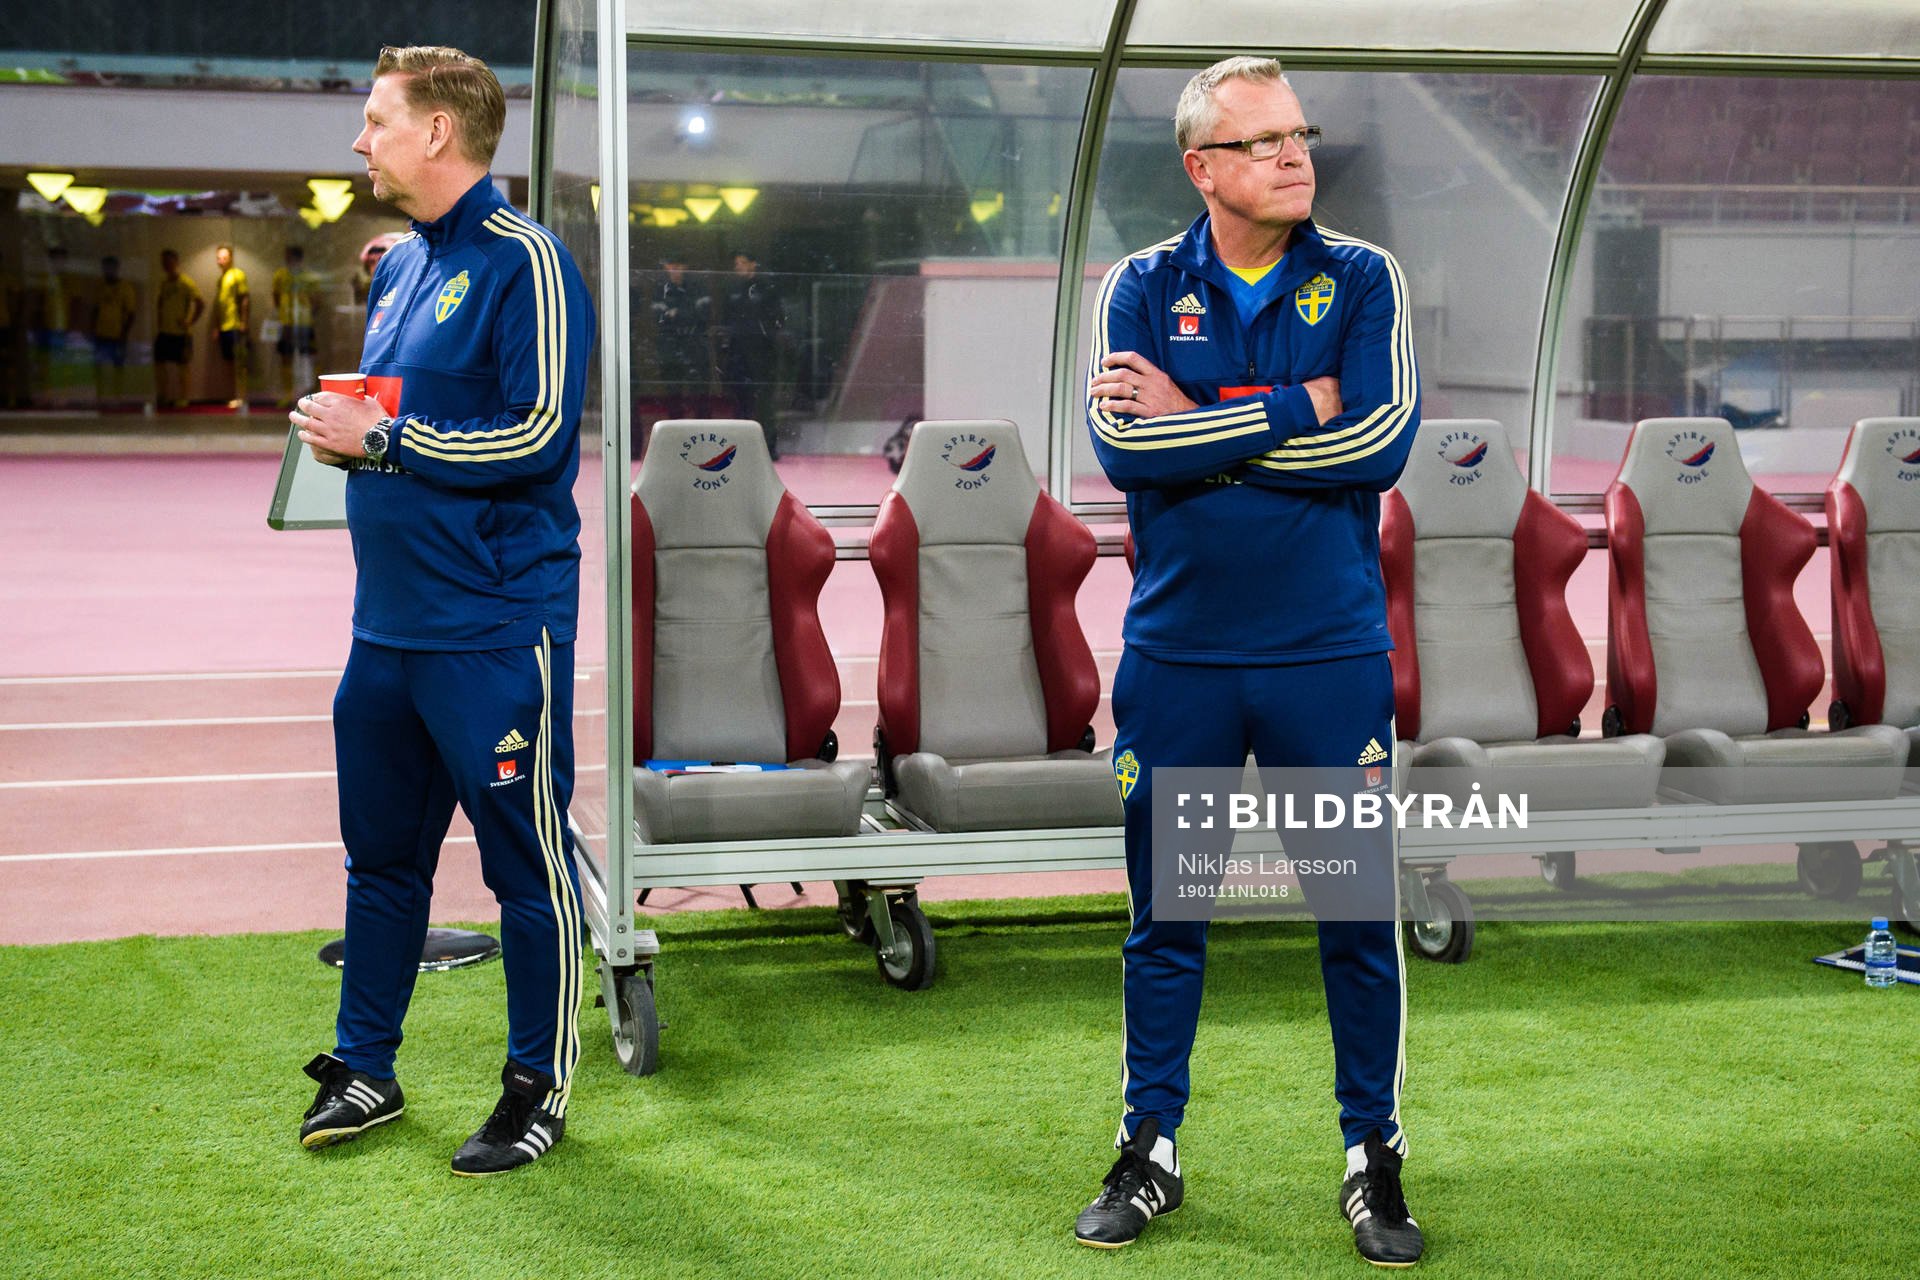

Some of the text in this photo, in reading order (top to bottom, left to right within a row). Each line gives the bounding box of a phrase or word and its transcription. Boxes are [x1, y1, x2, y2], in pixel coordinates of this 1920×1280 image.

[680, 433, 728, 461] ASPIRE
[941, 434, 987, 461] ASPIRE
[1438, 431, 1479, 458] ASPIRE
[1665, 431, 1706, 457] ASPIRE
[1886, 429, 1920, 455] ASPIR
[693, 474, 730, 491] ZONE
[955, 473, 991, 490] ZONE
[1449, 469, 1482, 486] ZONE
[1677, 469, 1709, 485] ZONE
[494, 740, 529, 754] adidas
